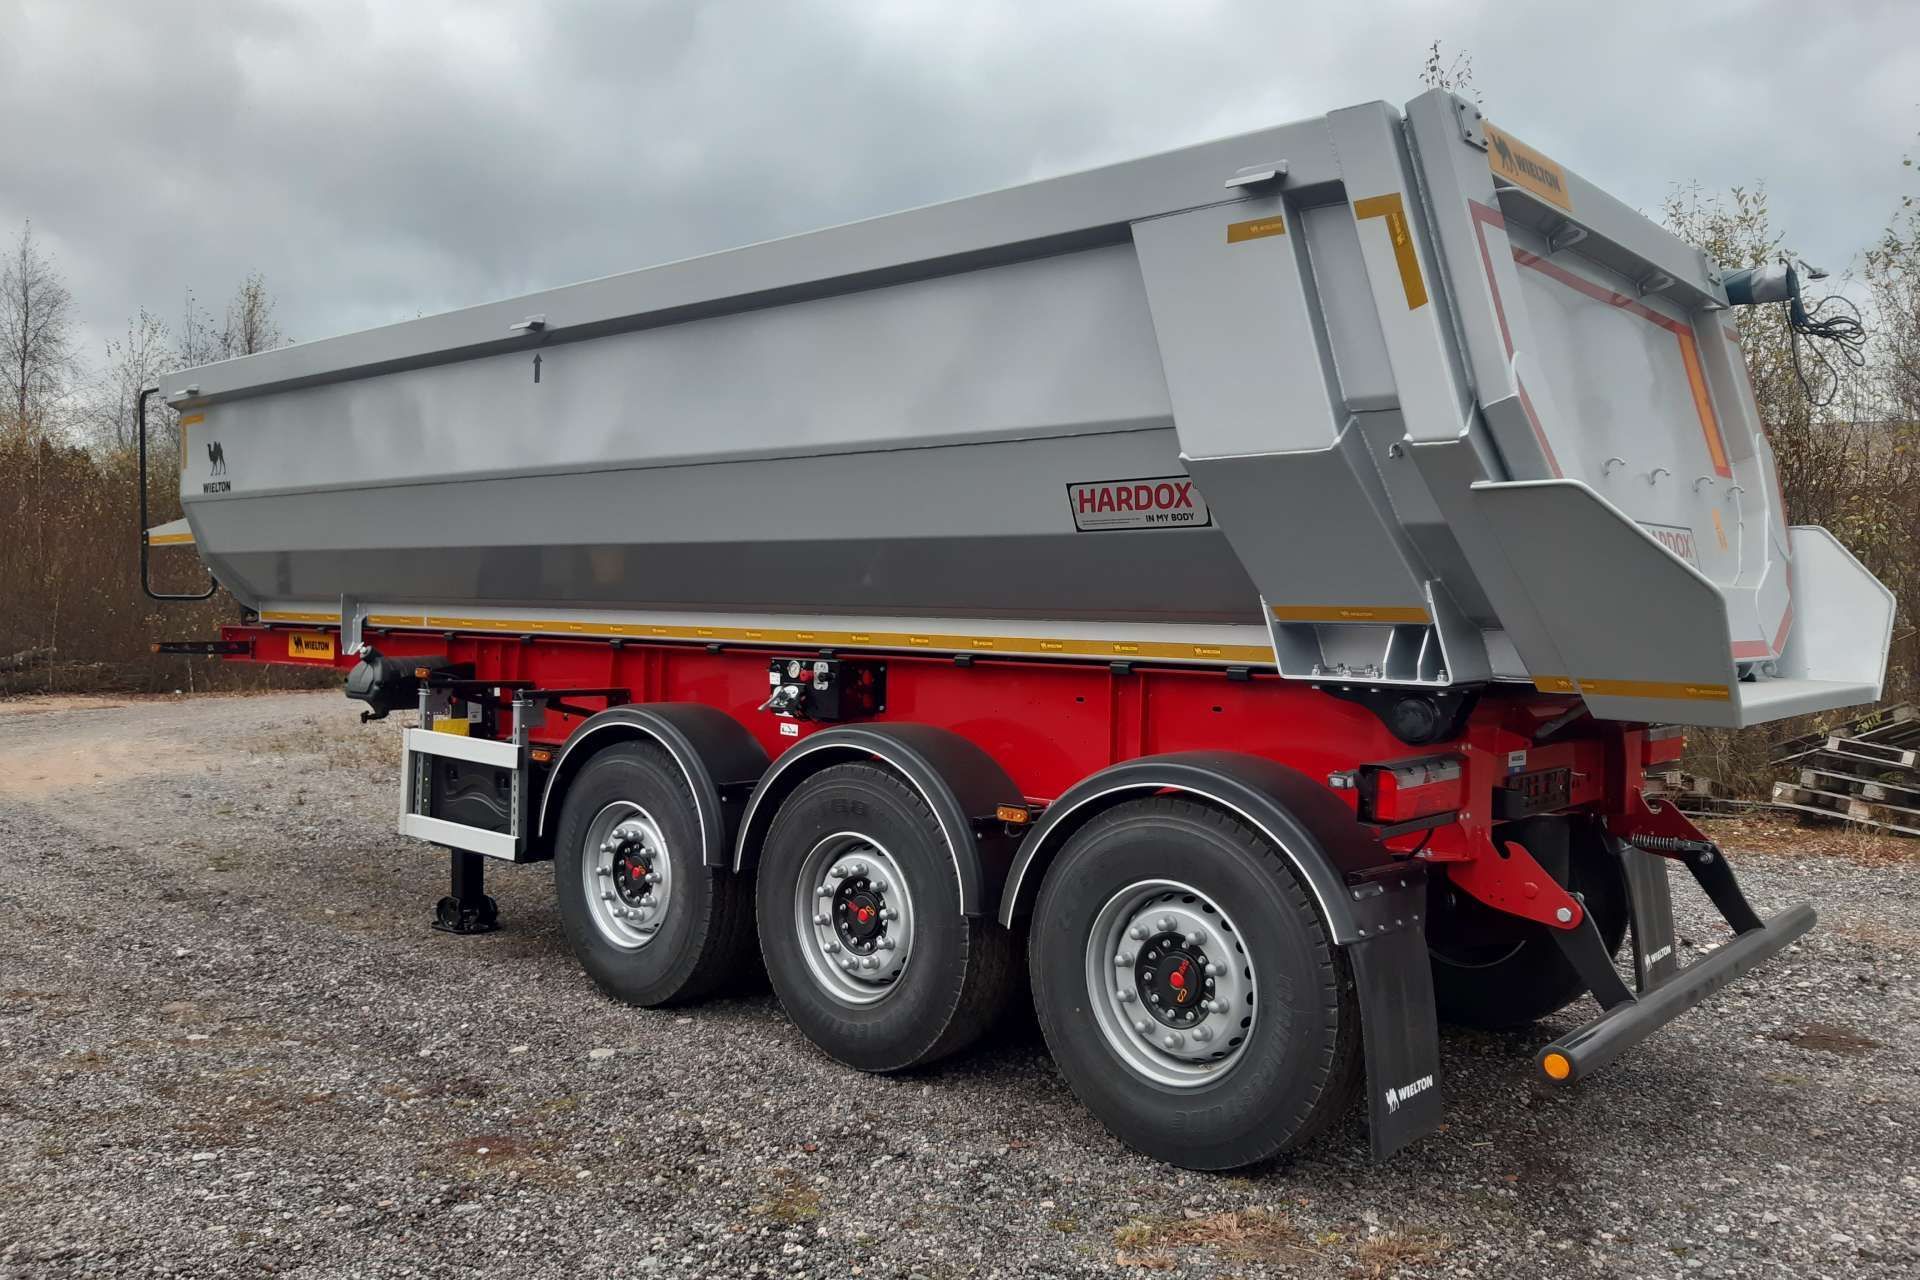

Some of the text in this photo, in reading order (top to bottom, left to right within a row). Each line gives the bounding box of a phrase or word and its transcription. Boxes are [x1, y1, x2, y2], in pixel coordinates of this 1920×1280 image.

[203, 481, 231, 493] WIELTON
[1078, 482, 1193, 514] HARDOX
[1145, 514, 1155, 523] IN
[1157, 514, 1169, 522] MY
[1171, 513, 1195, 521] BODY
[304, 640, 330, 651] WIELTON
[1398, 1074, 1433, 1101] WIELTON
